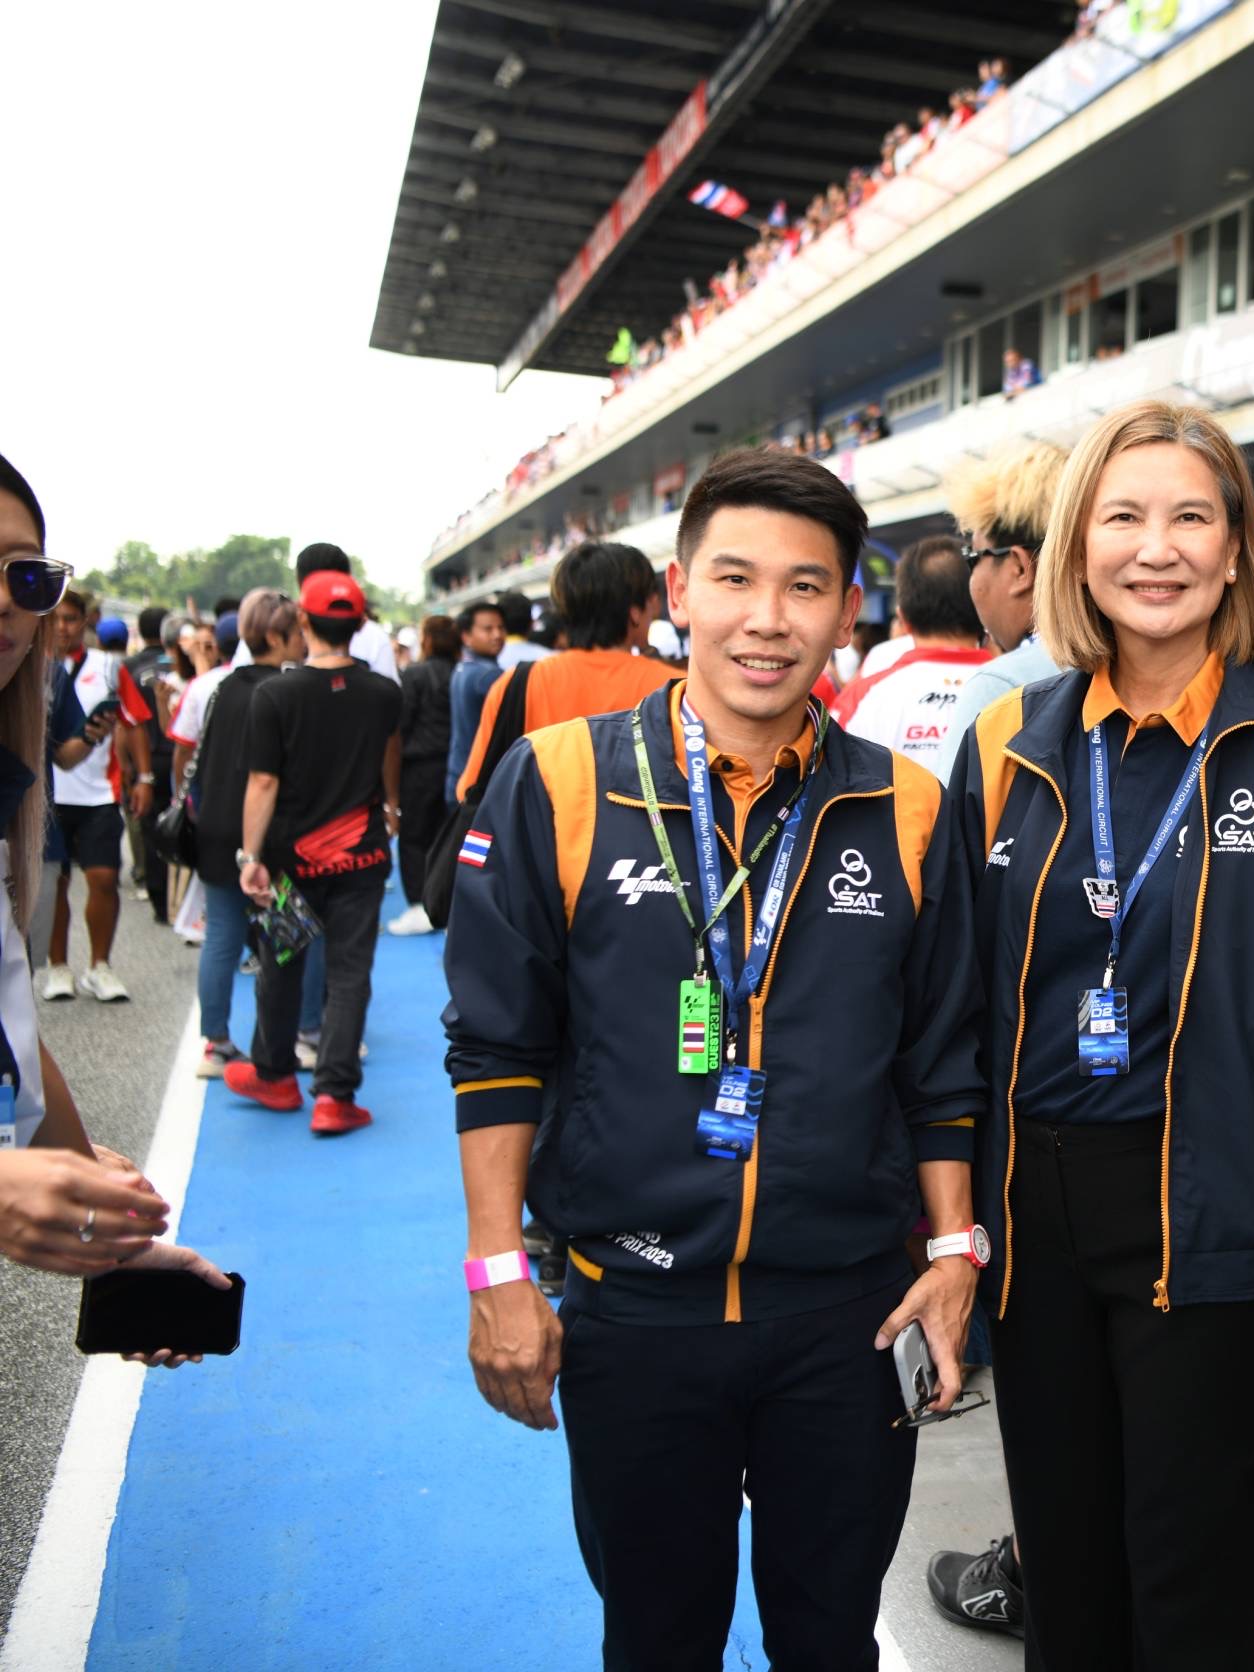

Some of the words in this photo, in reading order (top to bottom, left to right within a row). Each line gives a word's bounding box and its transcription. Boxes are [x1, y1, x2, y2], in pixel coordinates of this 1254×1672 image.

[906, 725, 949, 740] GA
[691, 757, 706, 795] Chang
[1095, 747, 1106, 811] INTERNATIONAL
[696, 797, 711, 870] INTERNATIONAL
[1097, 812, 1108, 847] CIRCUIT
[1153, 818, 1174, 852] CIRCUIT
[296, 848, 386, 879] HONDA
[834, 890, 883, 909] SAT
[1091, 1007, 1113, 1018] D2
[719, 1084, 747, 1098] D2
[639, 1245, 675, 1269] 2023
